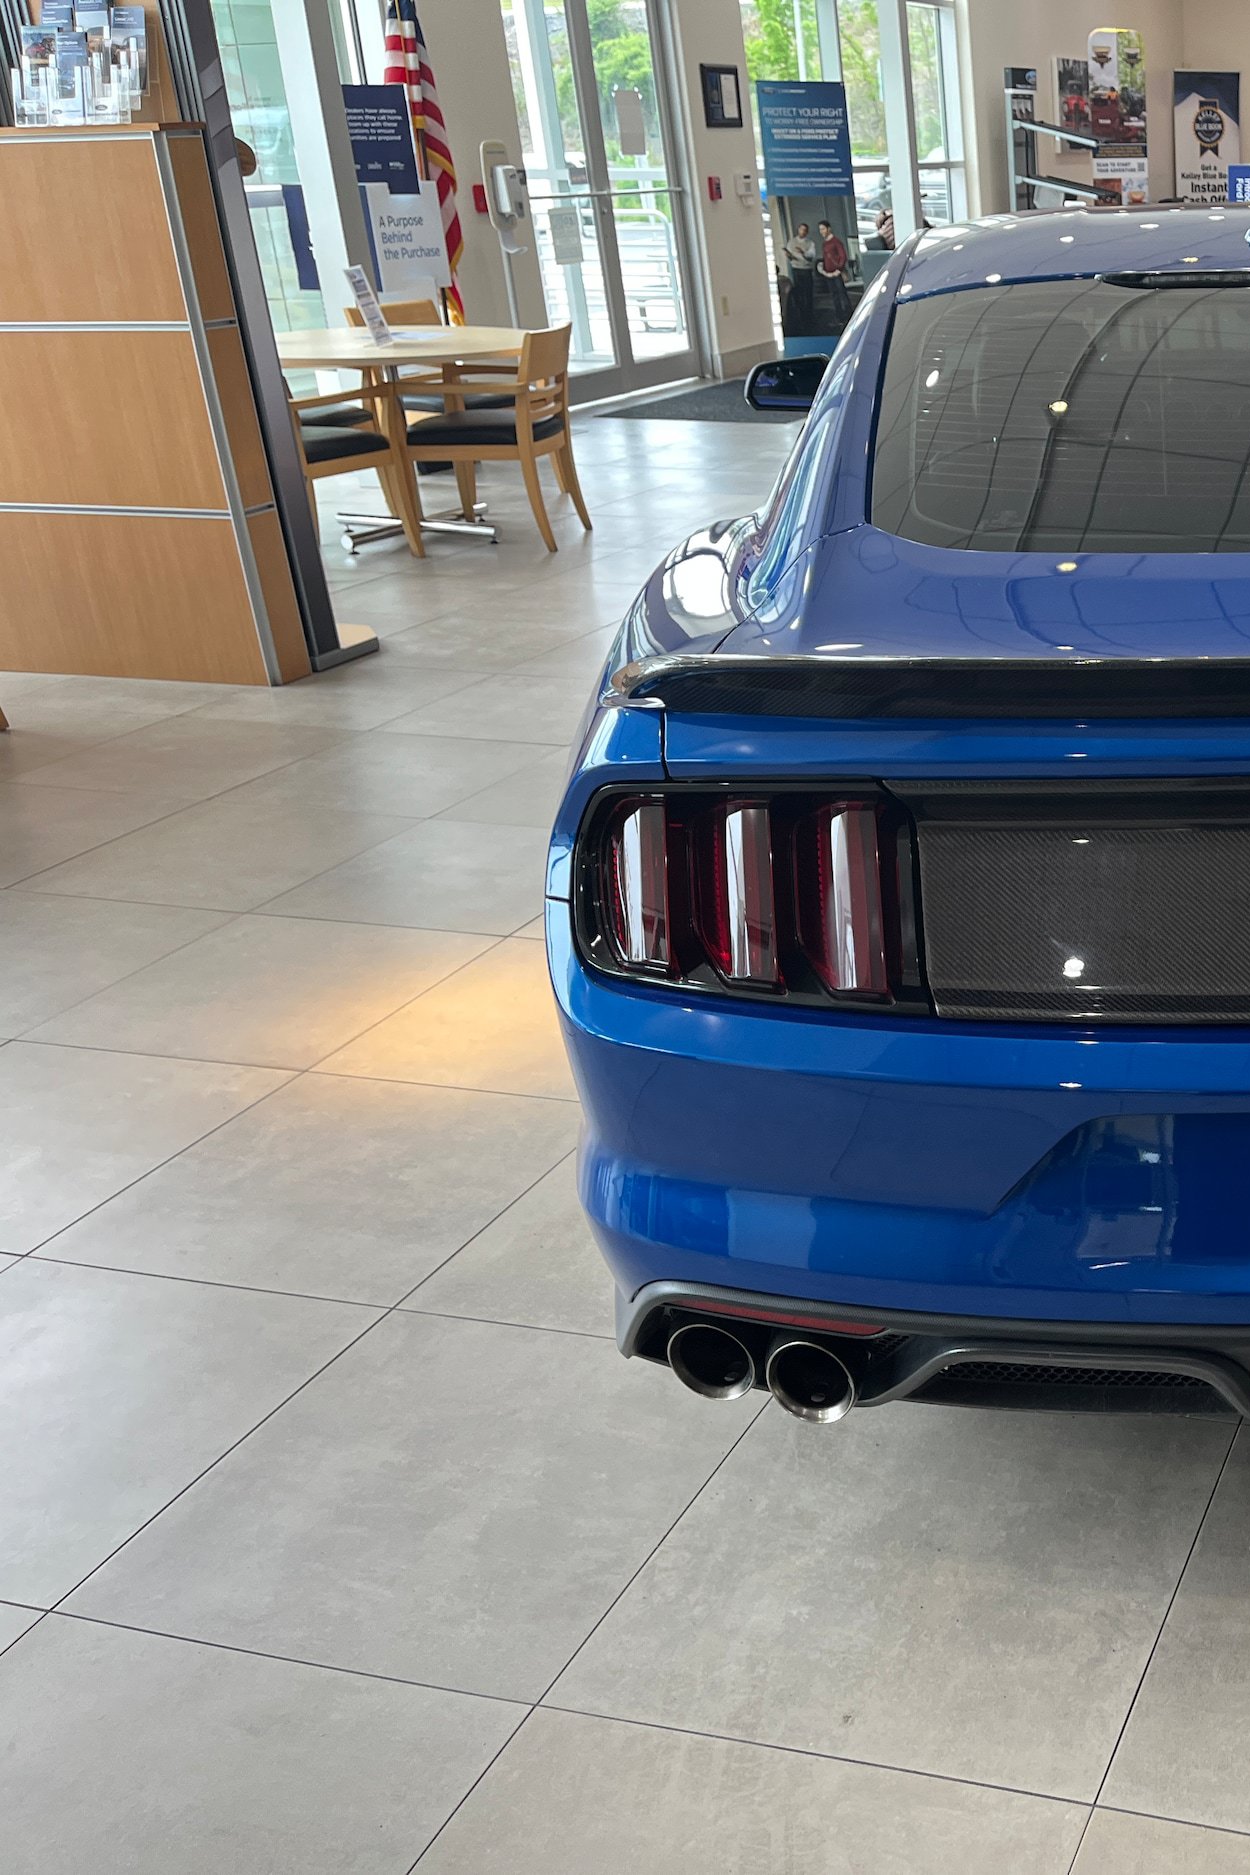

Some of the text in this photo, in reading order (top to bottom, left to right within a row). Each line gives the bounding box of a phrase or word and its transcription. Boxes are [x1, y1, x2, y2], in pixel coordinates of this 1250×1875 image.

[762, 107, 843, 117] PROTECT YOUR RIGHT
[810, 117, 843, 125] OWNERSHIP
[1181, 172, 1201, 180] Kelley
[1191, 182, 1228, 193] Instant
[1236, 178, 1244, 199] Ford
[379, 216, 424, 229] A Purpose
[381, 231, 412, 244] Behind
[384, 246, 440, 261] the Purchase
